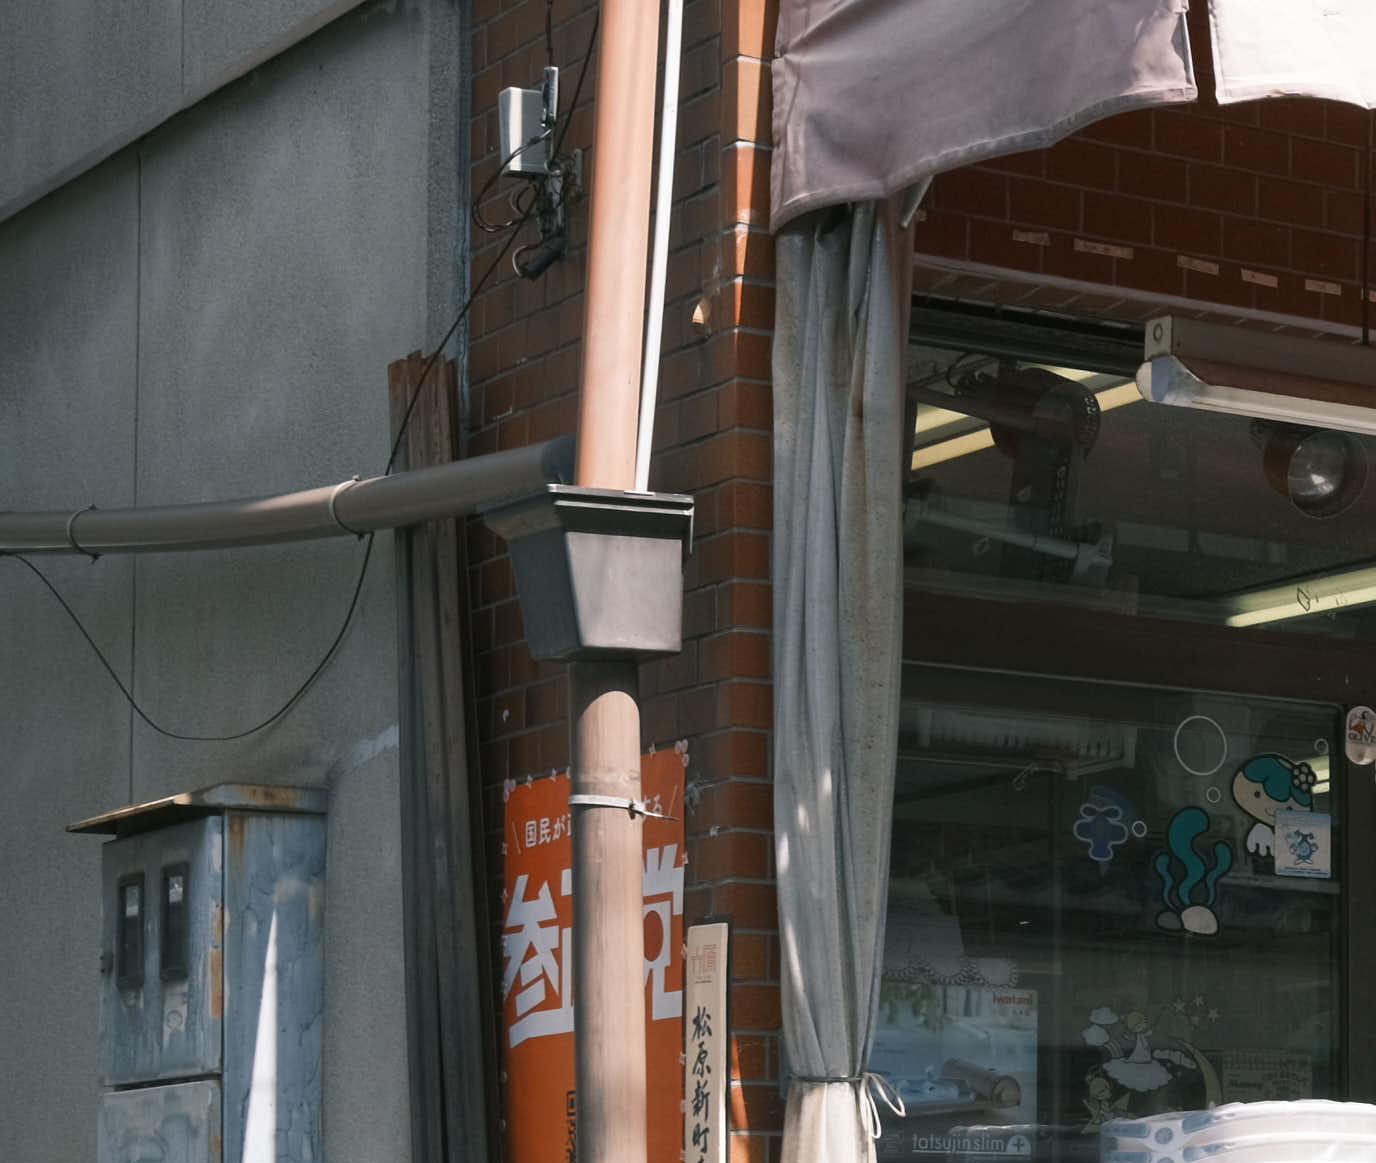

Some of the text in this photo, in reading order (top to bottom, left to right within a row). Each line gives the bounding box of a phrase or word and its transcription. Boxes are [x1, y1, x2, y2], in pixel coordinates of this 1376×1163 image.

[525, 813, 572, 848] 国民が
[972, 1134, 1004, 1151] slim
